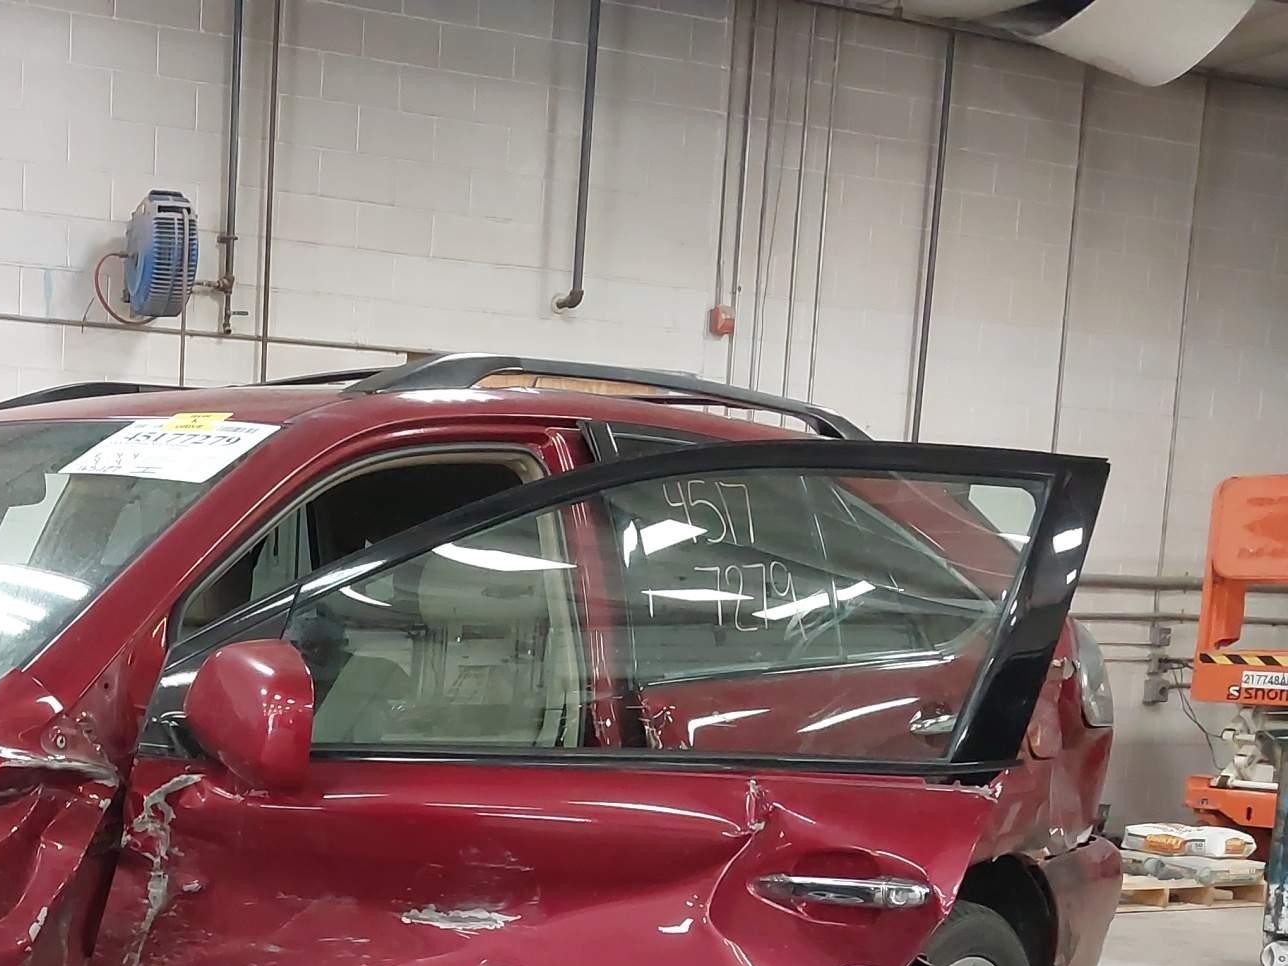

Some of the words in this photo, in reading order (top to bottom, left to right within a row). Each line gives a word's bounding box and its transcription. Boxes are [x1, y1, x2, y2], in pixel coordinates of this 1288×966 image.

[124, 431, 241, 447] 45177279
[661, 479, 755, 545] 4517
[694, 561, 808, 641] 7279
